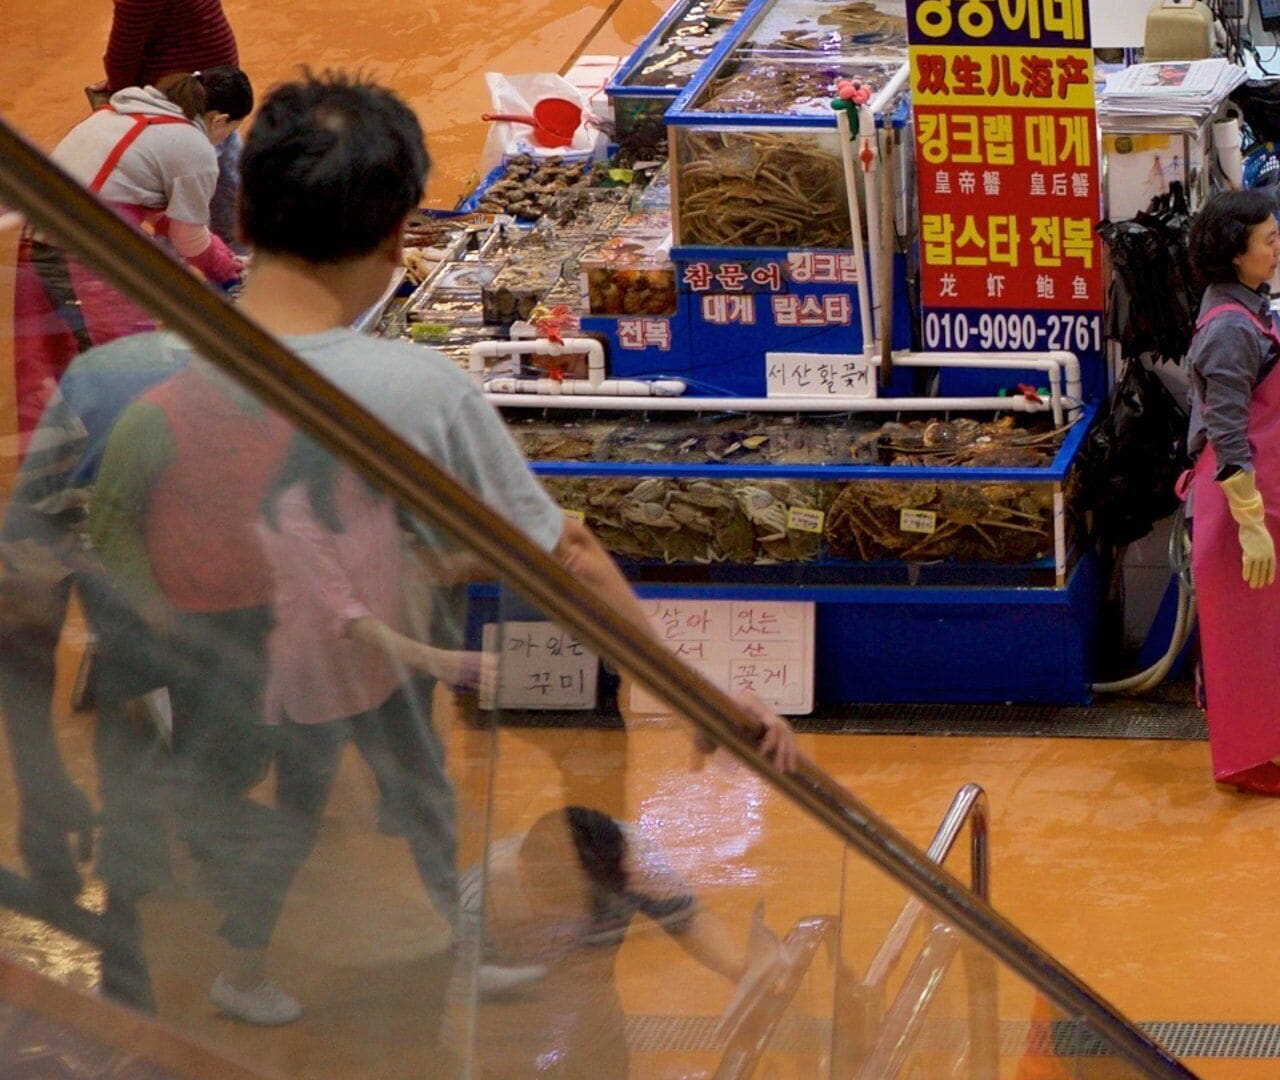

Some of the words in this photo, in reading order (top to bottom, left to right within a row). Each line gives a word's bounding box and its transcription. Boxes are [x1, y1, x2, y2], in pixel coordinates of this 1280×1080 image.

[915, 53, 1089, 100] 双生儿海产
[917, 113, 1015, 166] 킹크랩
[1024, 115, 1091, 167] 대게
[934, 170, 1001, 196] 皇帝蟹
[1030, 172, 1090, 198] 皇后蟹
[922, 213, 1021, 267] 랍스타
[1030, 215, 1094, 269] 전복
[683, 262, 782, 292] 참문어
[939, 272, 1006, 298] 龙虾
[1035, 273, 1090, 300] 鲍鱼
[702, 294, 756, 325] 대게
[771, 294, 852, 327] 랍스타
[617, 318, 671, 351] 전복
[925, 311, 1101, 352] 010-9090-2761
[662, 607, 712, 639] 살아
[735, 609, 782, 636] 있는
[733, 664, 788, 692] 꽃게
